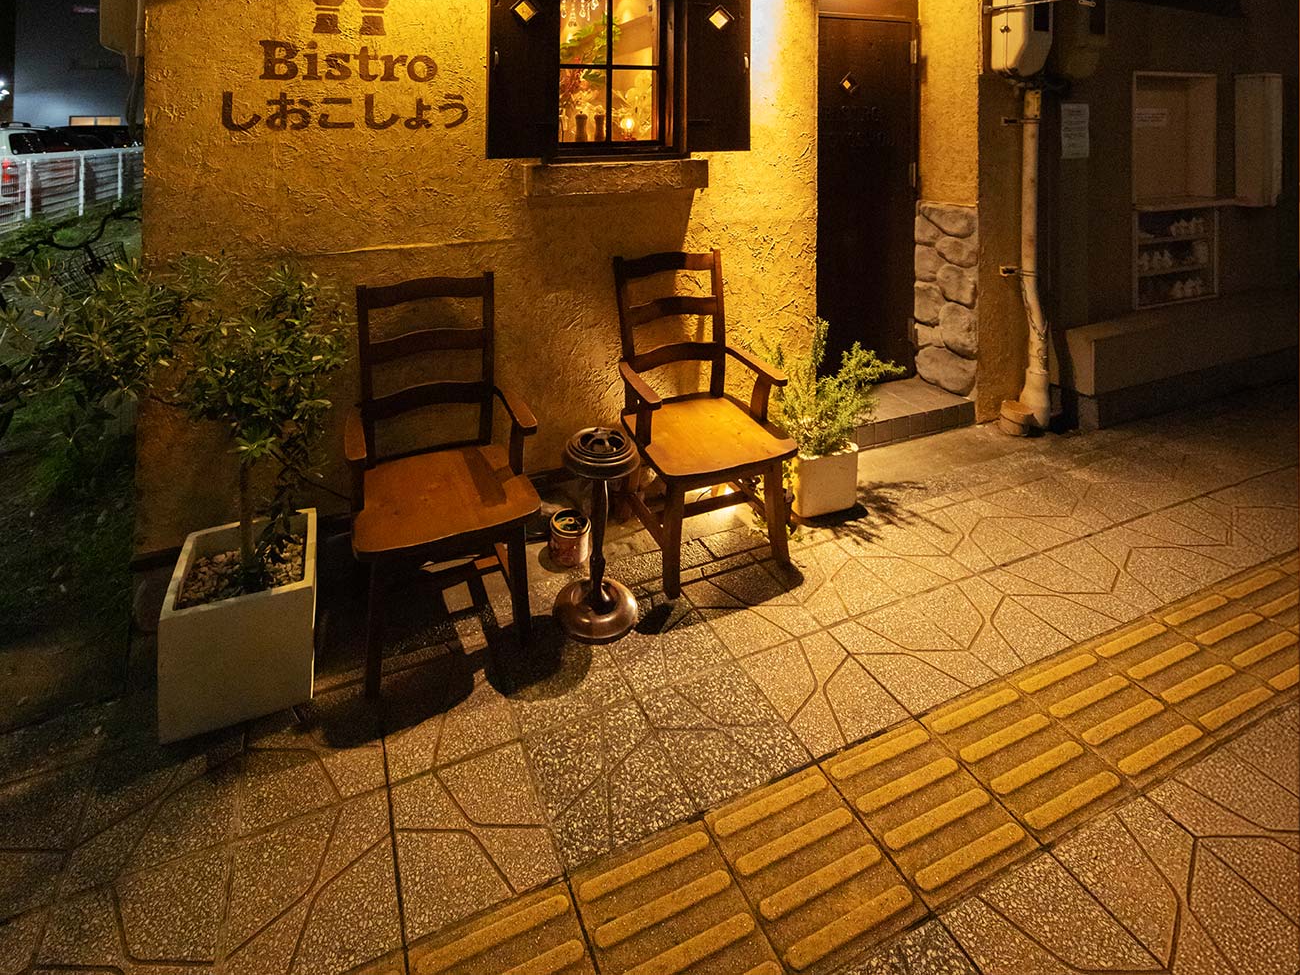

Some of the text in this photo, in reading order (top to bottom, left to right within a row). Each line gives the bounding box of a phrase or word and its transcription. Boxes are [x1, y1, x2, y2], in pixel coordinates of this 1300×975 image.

[259, 39, 438, 82] Bistro
[222, 91, 469, 131] しおこしょう
